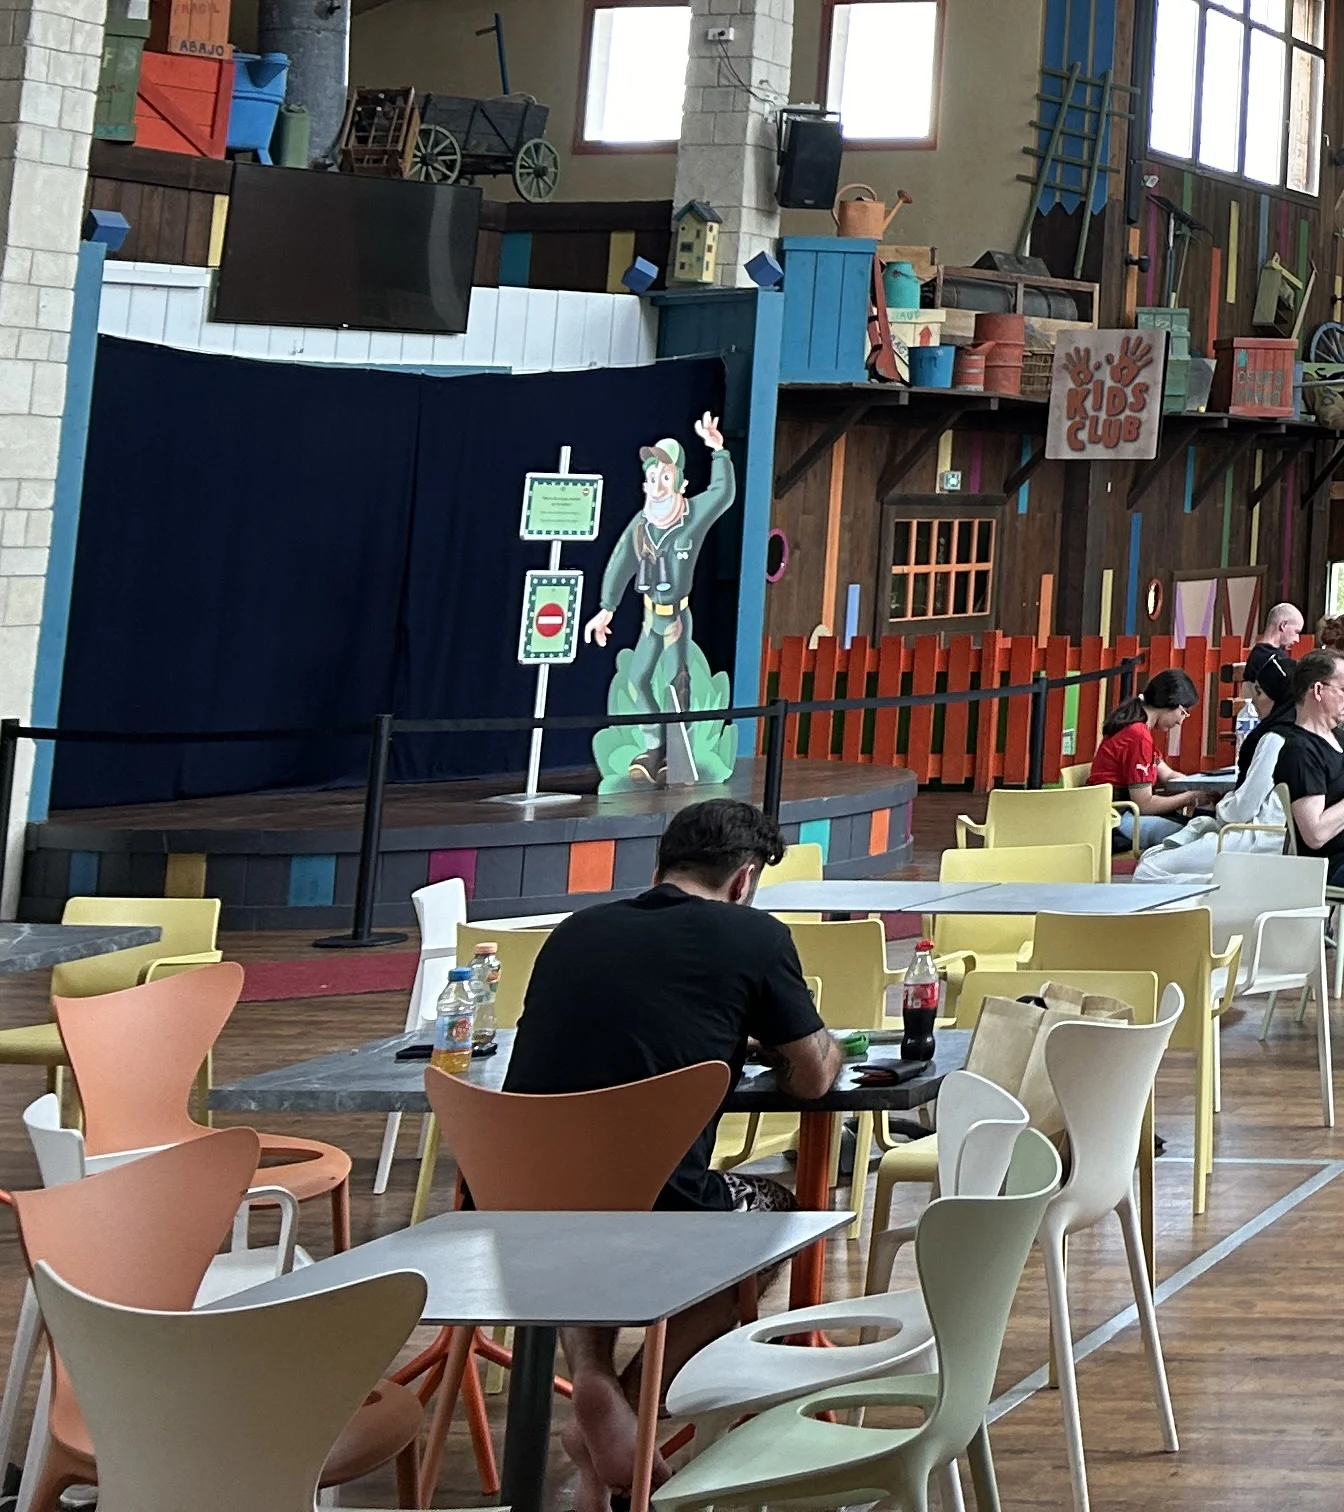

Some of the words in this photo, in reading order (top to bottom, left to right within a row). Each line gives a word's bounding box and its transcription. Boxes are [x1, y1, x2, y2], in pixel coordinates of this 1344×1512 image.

[180, 40, 225, 57] ABAJO
[1066, 379, 1149, 420] KIDS
[1066, 415, 1142, 451] CLUB
